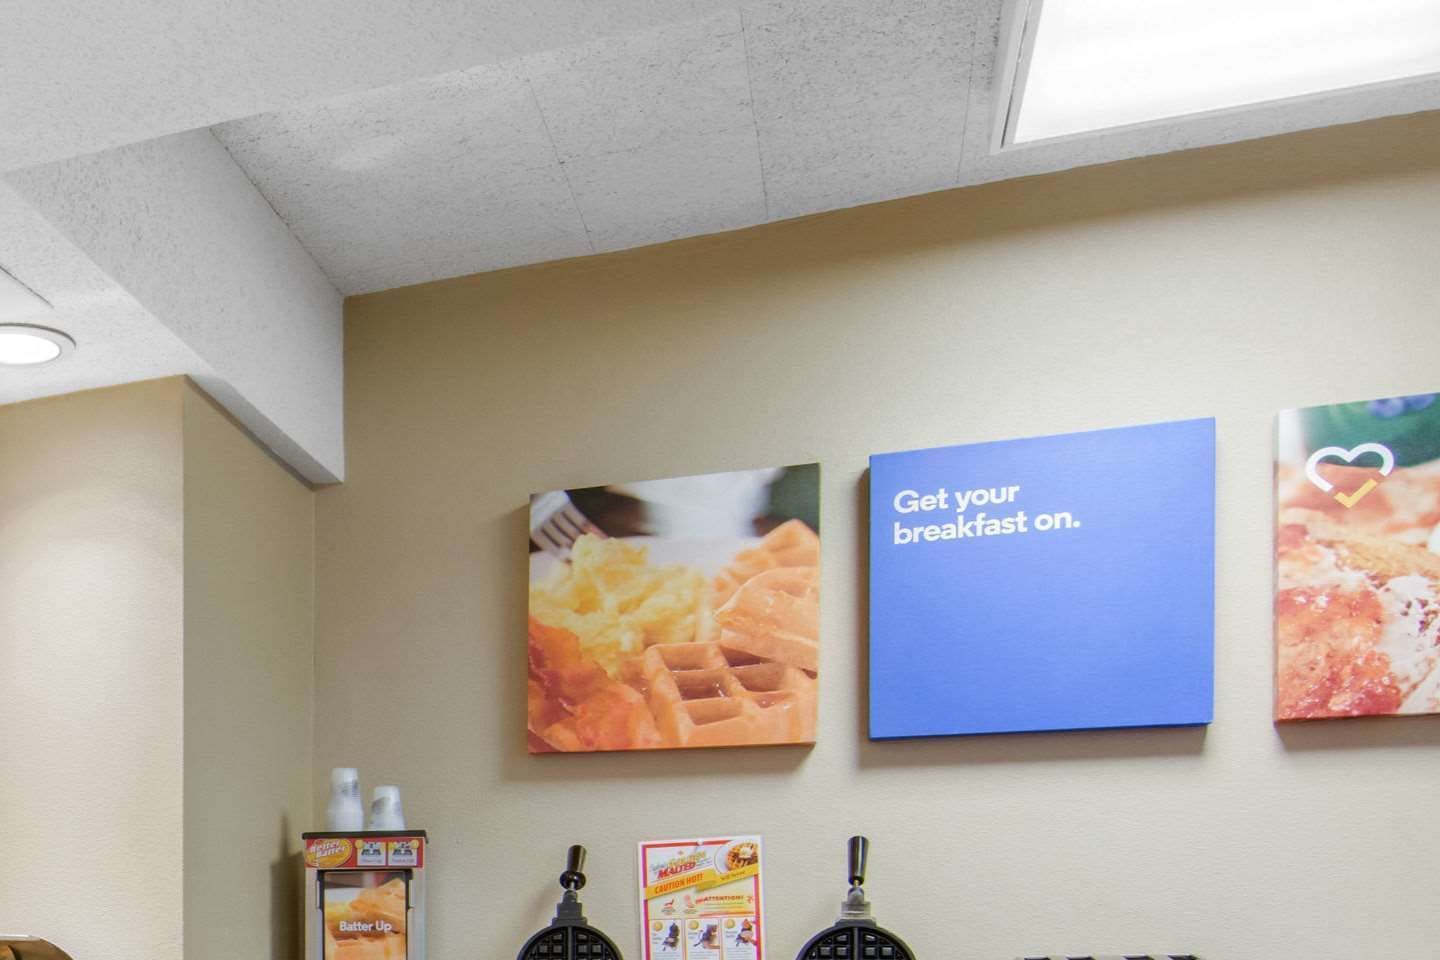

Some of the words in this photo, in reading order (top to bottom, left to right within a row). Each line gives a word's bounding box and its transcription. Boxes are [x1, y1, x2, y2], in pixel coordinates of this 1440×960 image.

[893, 487, 949, 514] Get
[954, 485, 1021, 513] your
[893, 510, 1028, 545] breakfast
[1033, 511, 1081, 531] on.
[654, 879, 685, 894] CAUTION
[339, 920, 374, 932] Batter
[375, 920, 392, 933] Up
